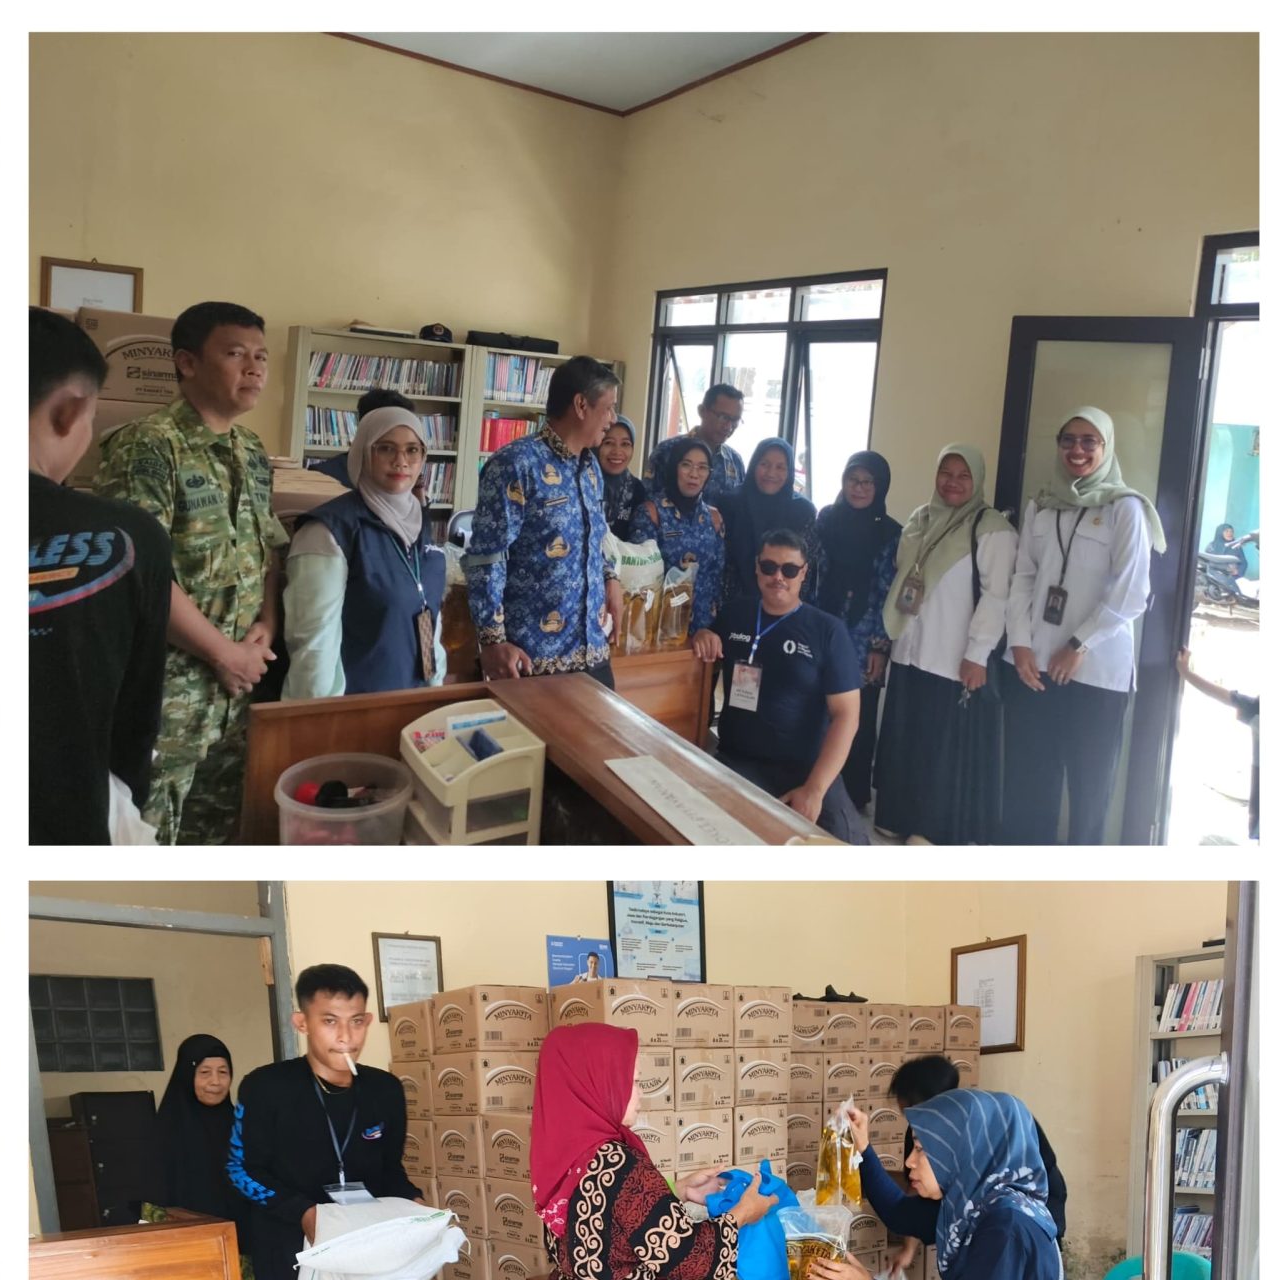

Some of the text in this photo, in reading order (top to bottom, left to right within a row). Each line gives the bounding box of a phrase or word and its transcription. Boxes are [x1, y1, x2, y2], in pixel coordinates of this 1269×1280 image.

[122, 345, 175, 361] MINYAK
[494, 1008, 532, 1021] MINYAKITA
[620, 1005, 657, 1017] MINYAKITA
[685, 1007, 719, 1018] MINYAKITA
[747, 1009, 779, 1020] MINYAKITA
[689, 1071, 721, 1082] MINYAKITA
[748, 1068, 779, 1079] MINYAKITA
[494, 1074, 531, 1087] MINYAKITA
[687, 1133, 719, 1144] MINYAKITA
